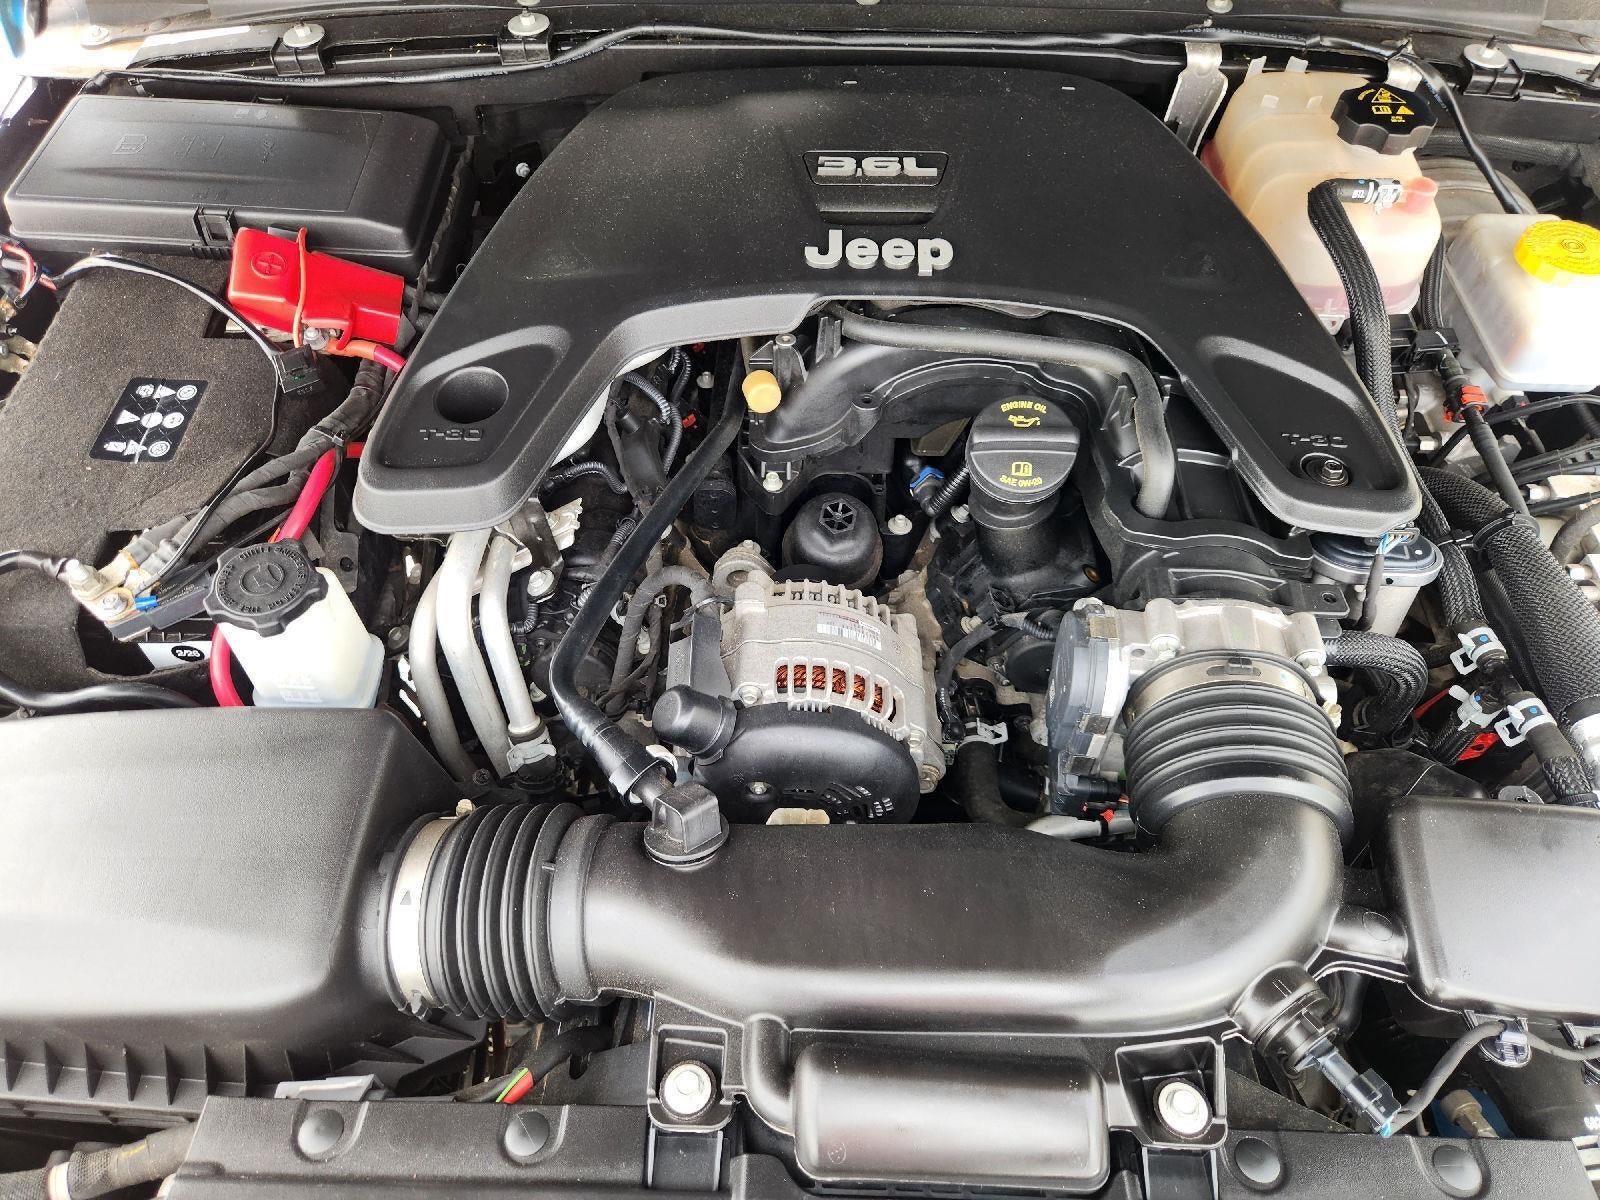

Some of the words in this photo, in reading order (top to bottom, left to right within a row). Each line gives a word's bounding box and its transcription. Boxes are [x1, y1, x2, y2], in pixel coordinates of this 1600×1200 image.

[817, 156, 938, 177] 3.6L
[804, 229, 954, 277] Jeep
[1000, 400, 1034, 413] ENGINE
[1033, 402, 1048, 414] OIL
[999, 474, 1018, 487] SAE
